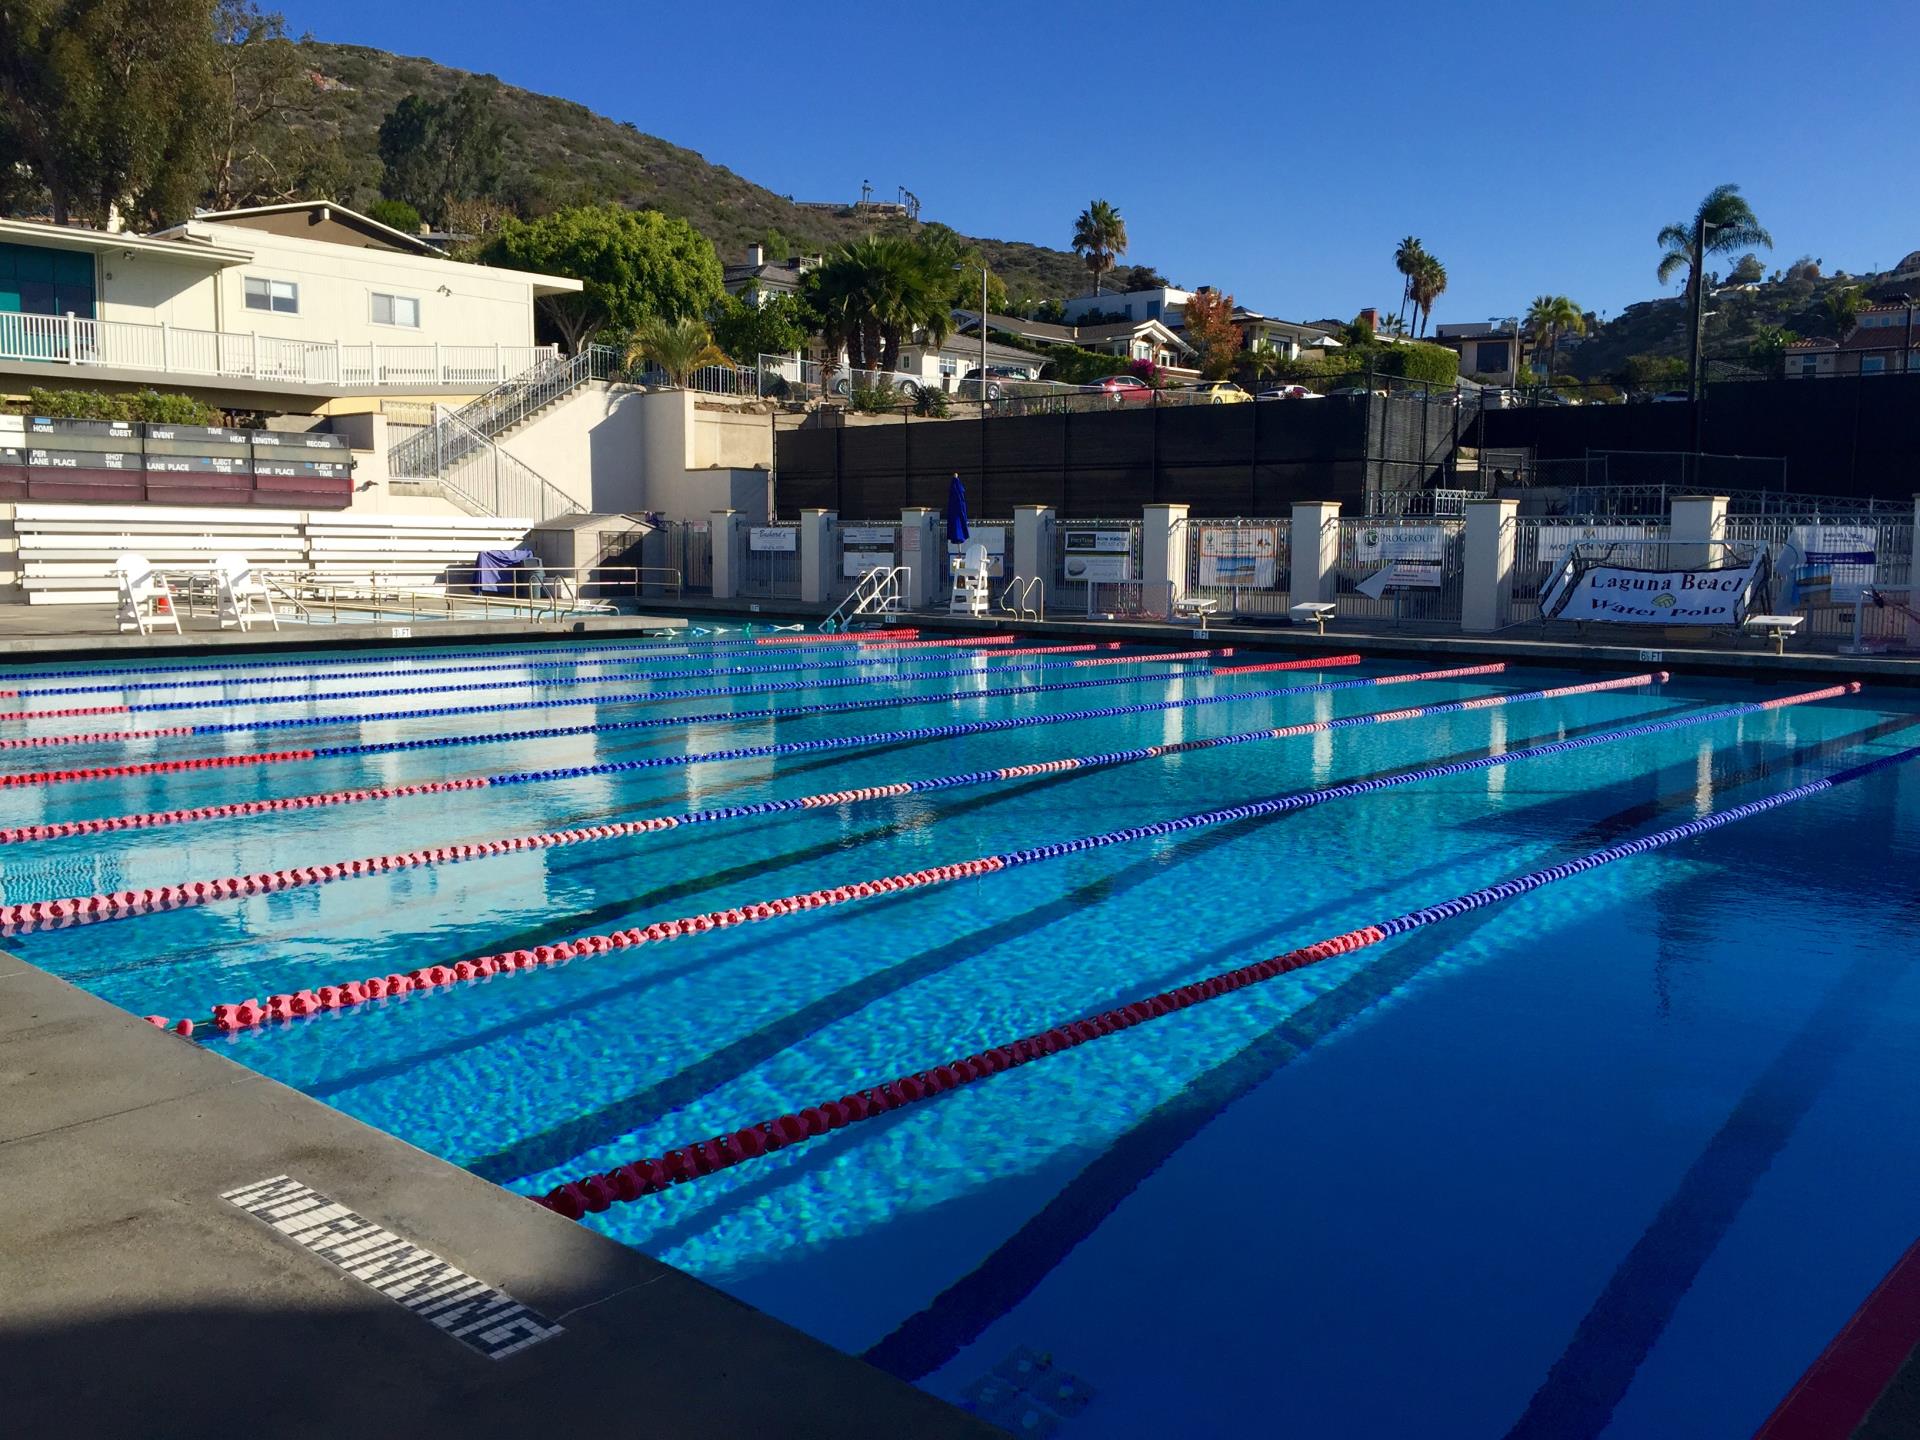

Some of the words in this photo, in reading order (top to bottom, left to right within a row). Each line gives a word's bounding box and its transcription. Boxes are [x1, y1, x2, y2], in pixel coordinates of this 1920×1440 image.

[33, 425, 54, 433] HOME
[109, 429, 132, 437] GUEST
[152, 431, 174, 439] EVENT
[252, 437, 279, 445] LENGTHS
[306, 440, 331, 448] RECORD
[29, 458, 49, 466] LANE
[53, 459, 76, 467] PLACE
[146, 462, 165, 470] LANE
[168, 463, 189, 471] PLACE
[254, 467, 271, 475] LANE
[275, 468, 295, 476] PLACE
[1549, 543, 1594, 551] MODRN
[1591, 575, 1671, 591] Laguna
[1591, 598, 1657, 617] Water
[1670, 606, 1726, 617] Polo
[224, 1176, 335, 1226] NO
[285, 1211, 558, 1355] RUNNING
